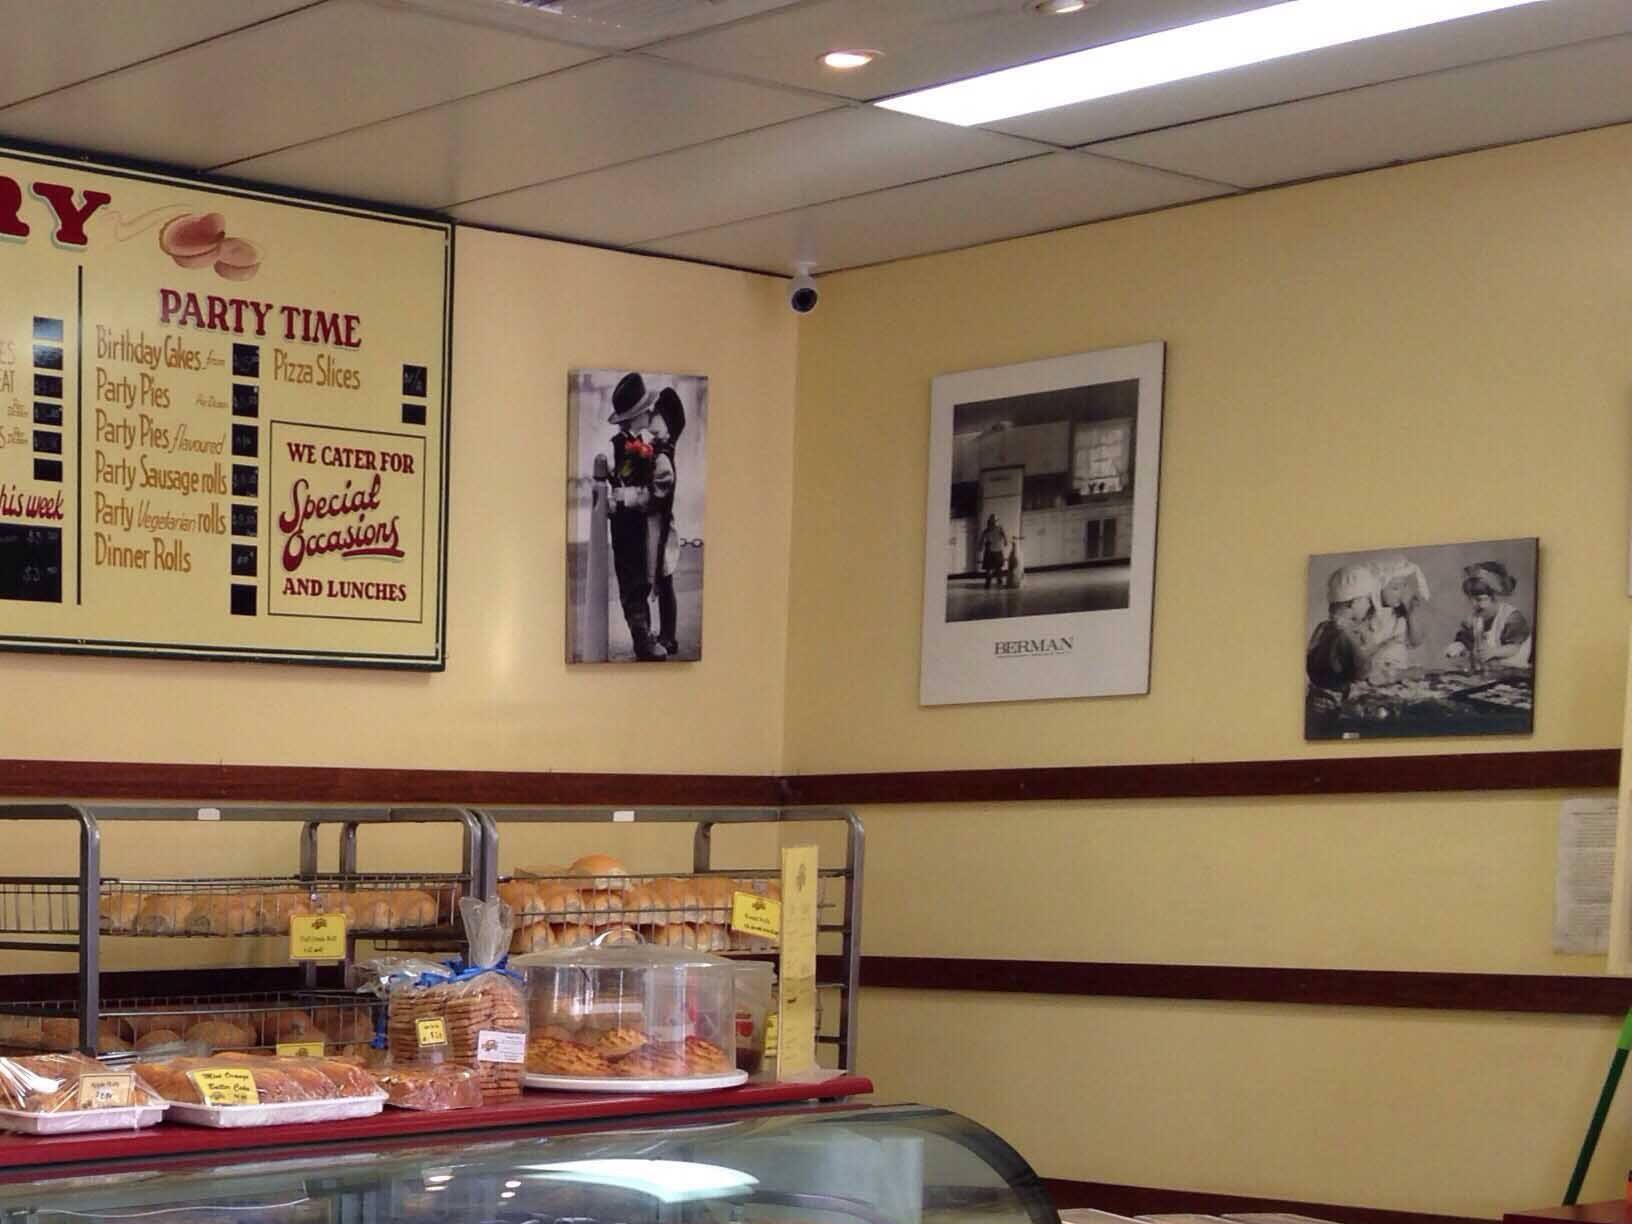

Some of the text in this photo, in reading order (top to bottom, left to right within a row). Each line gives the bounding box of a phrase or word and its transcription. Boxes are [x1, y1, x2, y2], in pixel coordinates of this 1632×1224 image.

[160, 287, 362, 348] PARTY TIME
[96, 324, 162, 370] Birthday
[163, 334, 202, 371] Cakes
[273, 347, 314, 384] Pizza
[316, 353, 361, 390] Slices
[96, 366, 171, 409] Party Pies
[95, 407, 136, 450] Party
[138, 412, 170, 449] Pies
[95, 450, 228, 496] Party Sausage rolls
[287, 441, 415, 474] WE CATER FOR
[25, 489, 65, 521] week
[94, 491, 135, 532] Party
[197, 502, 227, 535] rolls
[279, 472, 382, 534] Special
[94, 531, 192, 573] Dinner Rolls
[282, 514, 401, 572] Occasions
[282, 577, 407, 602] AND LUNCHES
[994, 636, 1074, 656] BERMAN
